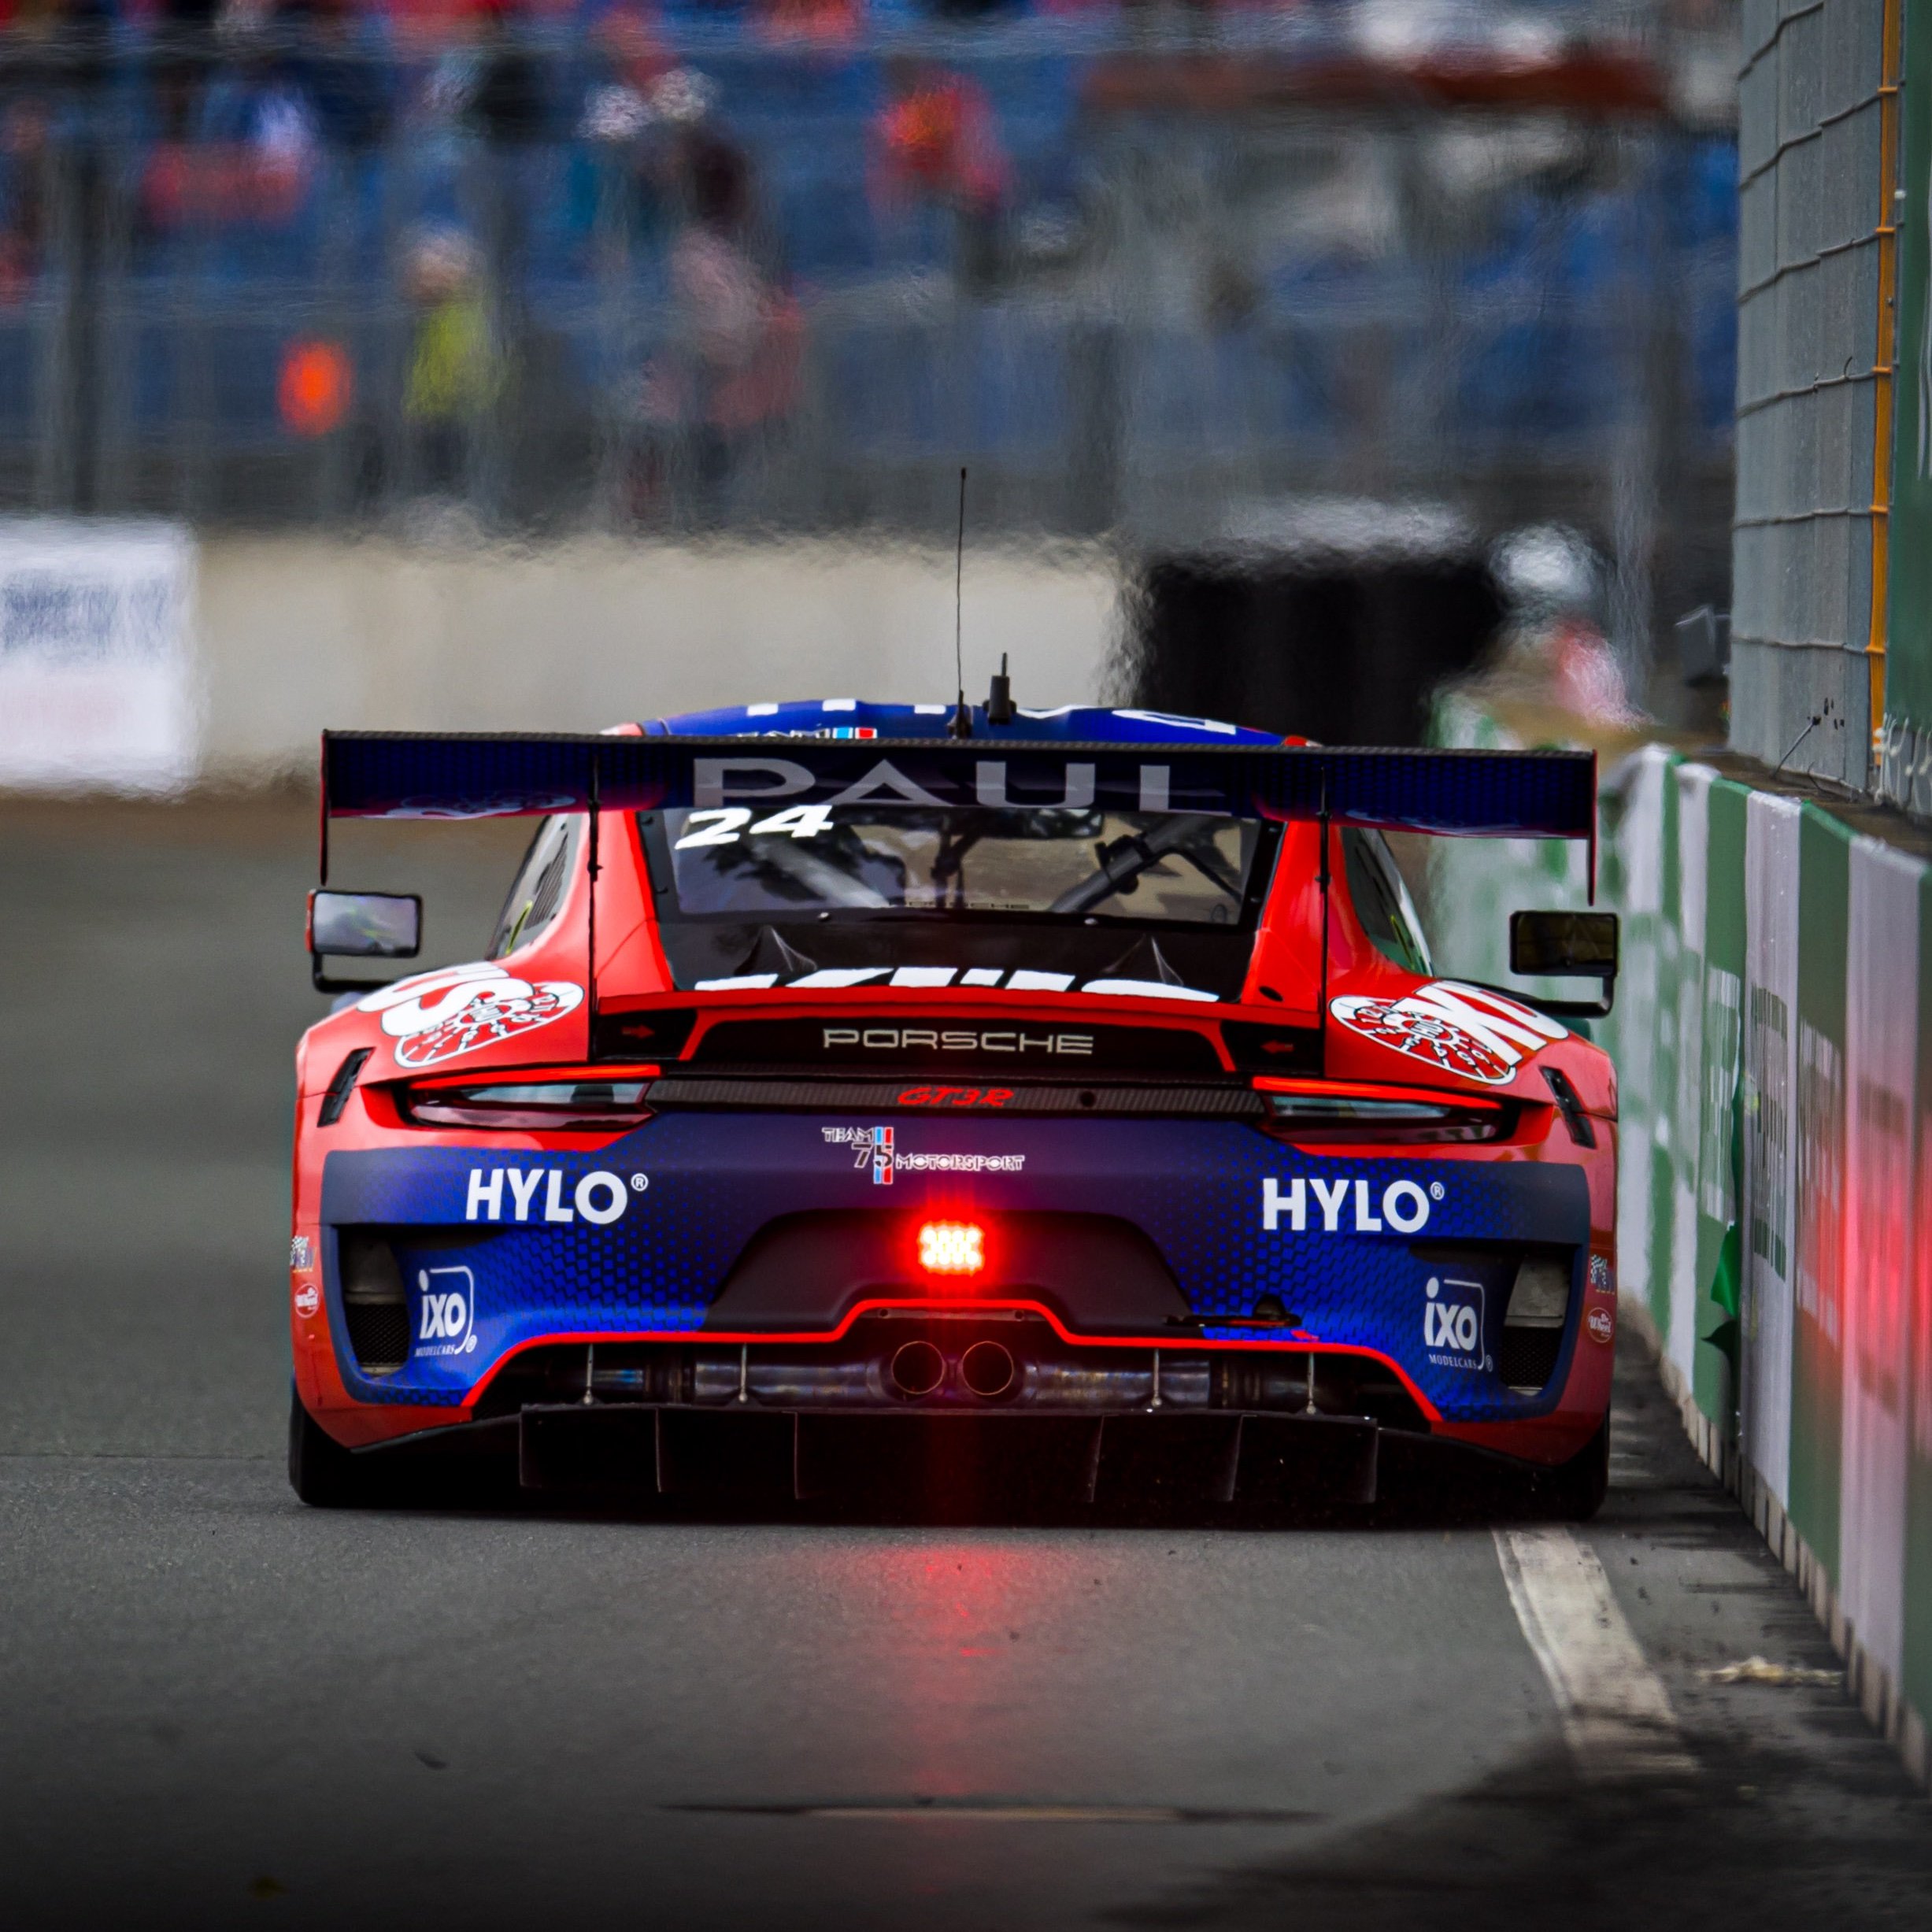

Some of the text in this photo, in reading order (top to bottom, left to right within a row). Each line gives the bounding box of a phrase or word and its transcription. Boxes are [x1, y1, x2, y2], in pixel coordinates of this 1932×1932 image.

[694, 758, 1232, 816] PAUL
[675, 805, 833, 849] 24
[823, 1028, 1094, 1055] PORSCHE
[822, 1127, 875, 1142] TEAM
[851, 1143, 1025, 1171] 75 MOTORSPORT
[1428, 1354, 1478, 1370] MODELCARS
